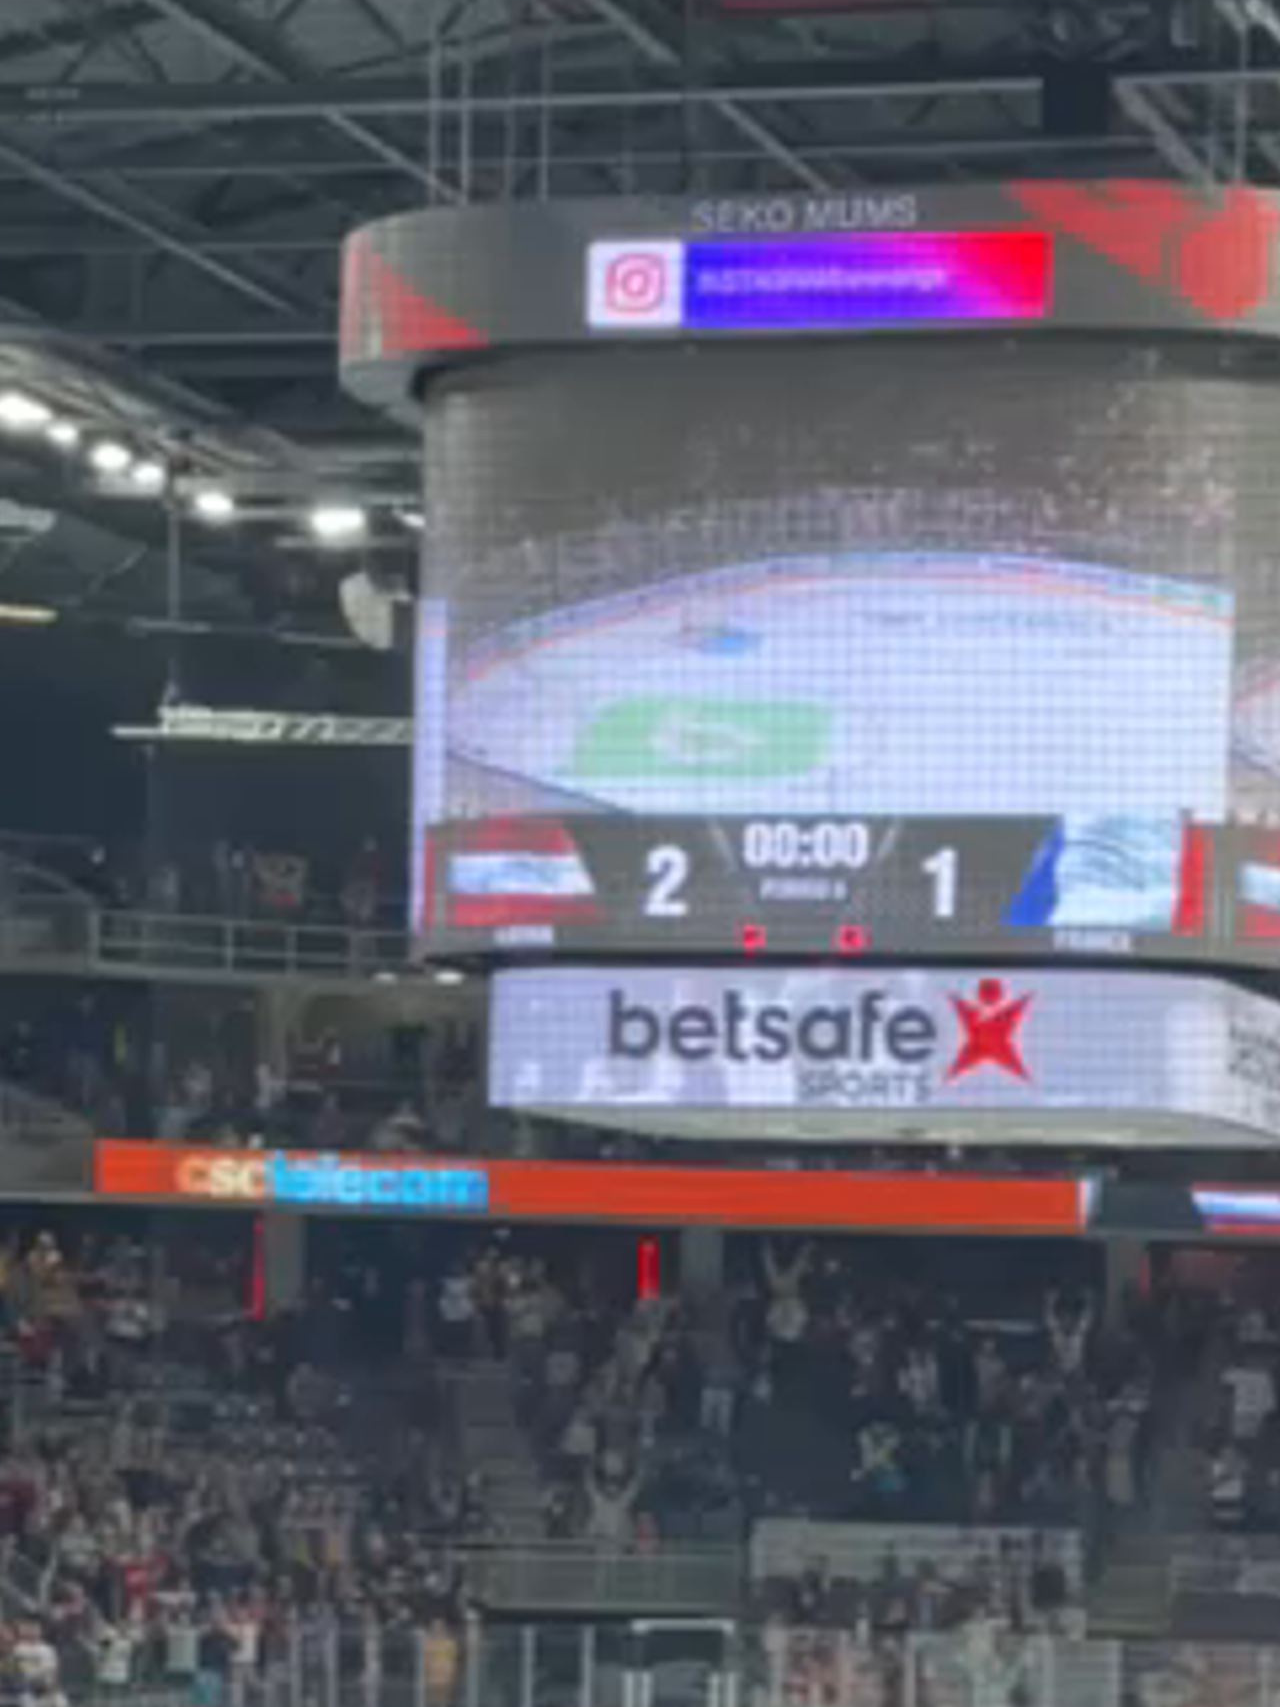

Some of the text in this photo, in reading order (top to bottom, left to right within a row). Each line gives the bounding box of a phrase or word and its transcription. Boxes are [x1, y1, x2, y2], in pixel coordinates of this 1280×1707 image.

[805, 195, 917, 229] MUMS
[743, 823, 869, 868] 00:00
[643, 846, 689, 916] 2
[922, 849, 958, 917] 1
[609, 990, 937, 1062] betsafe
[796, 1070, 929, 1103] SPORTS
